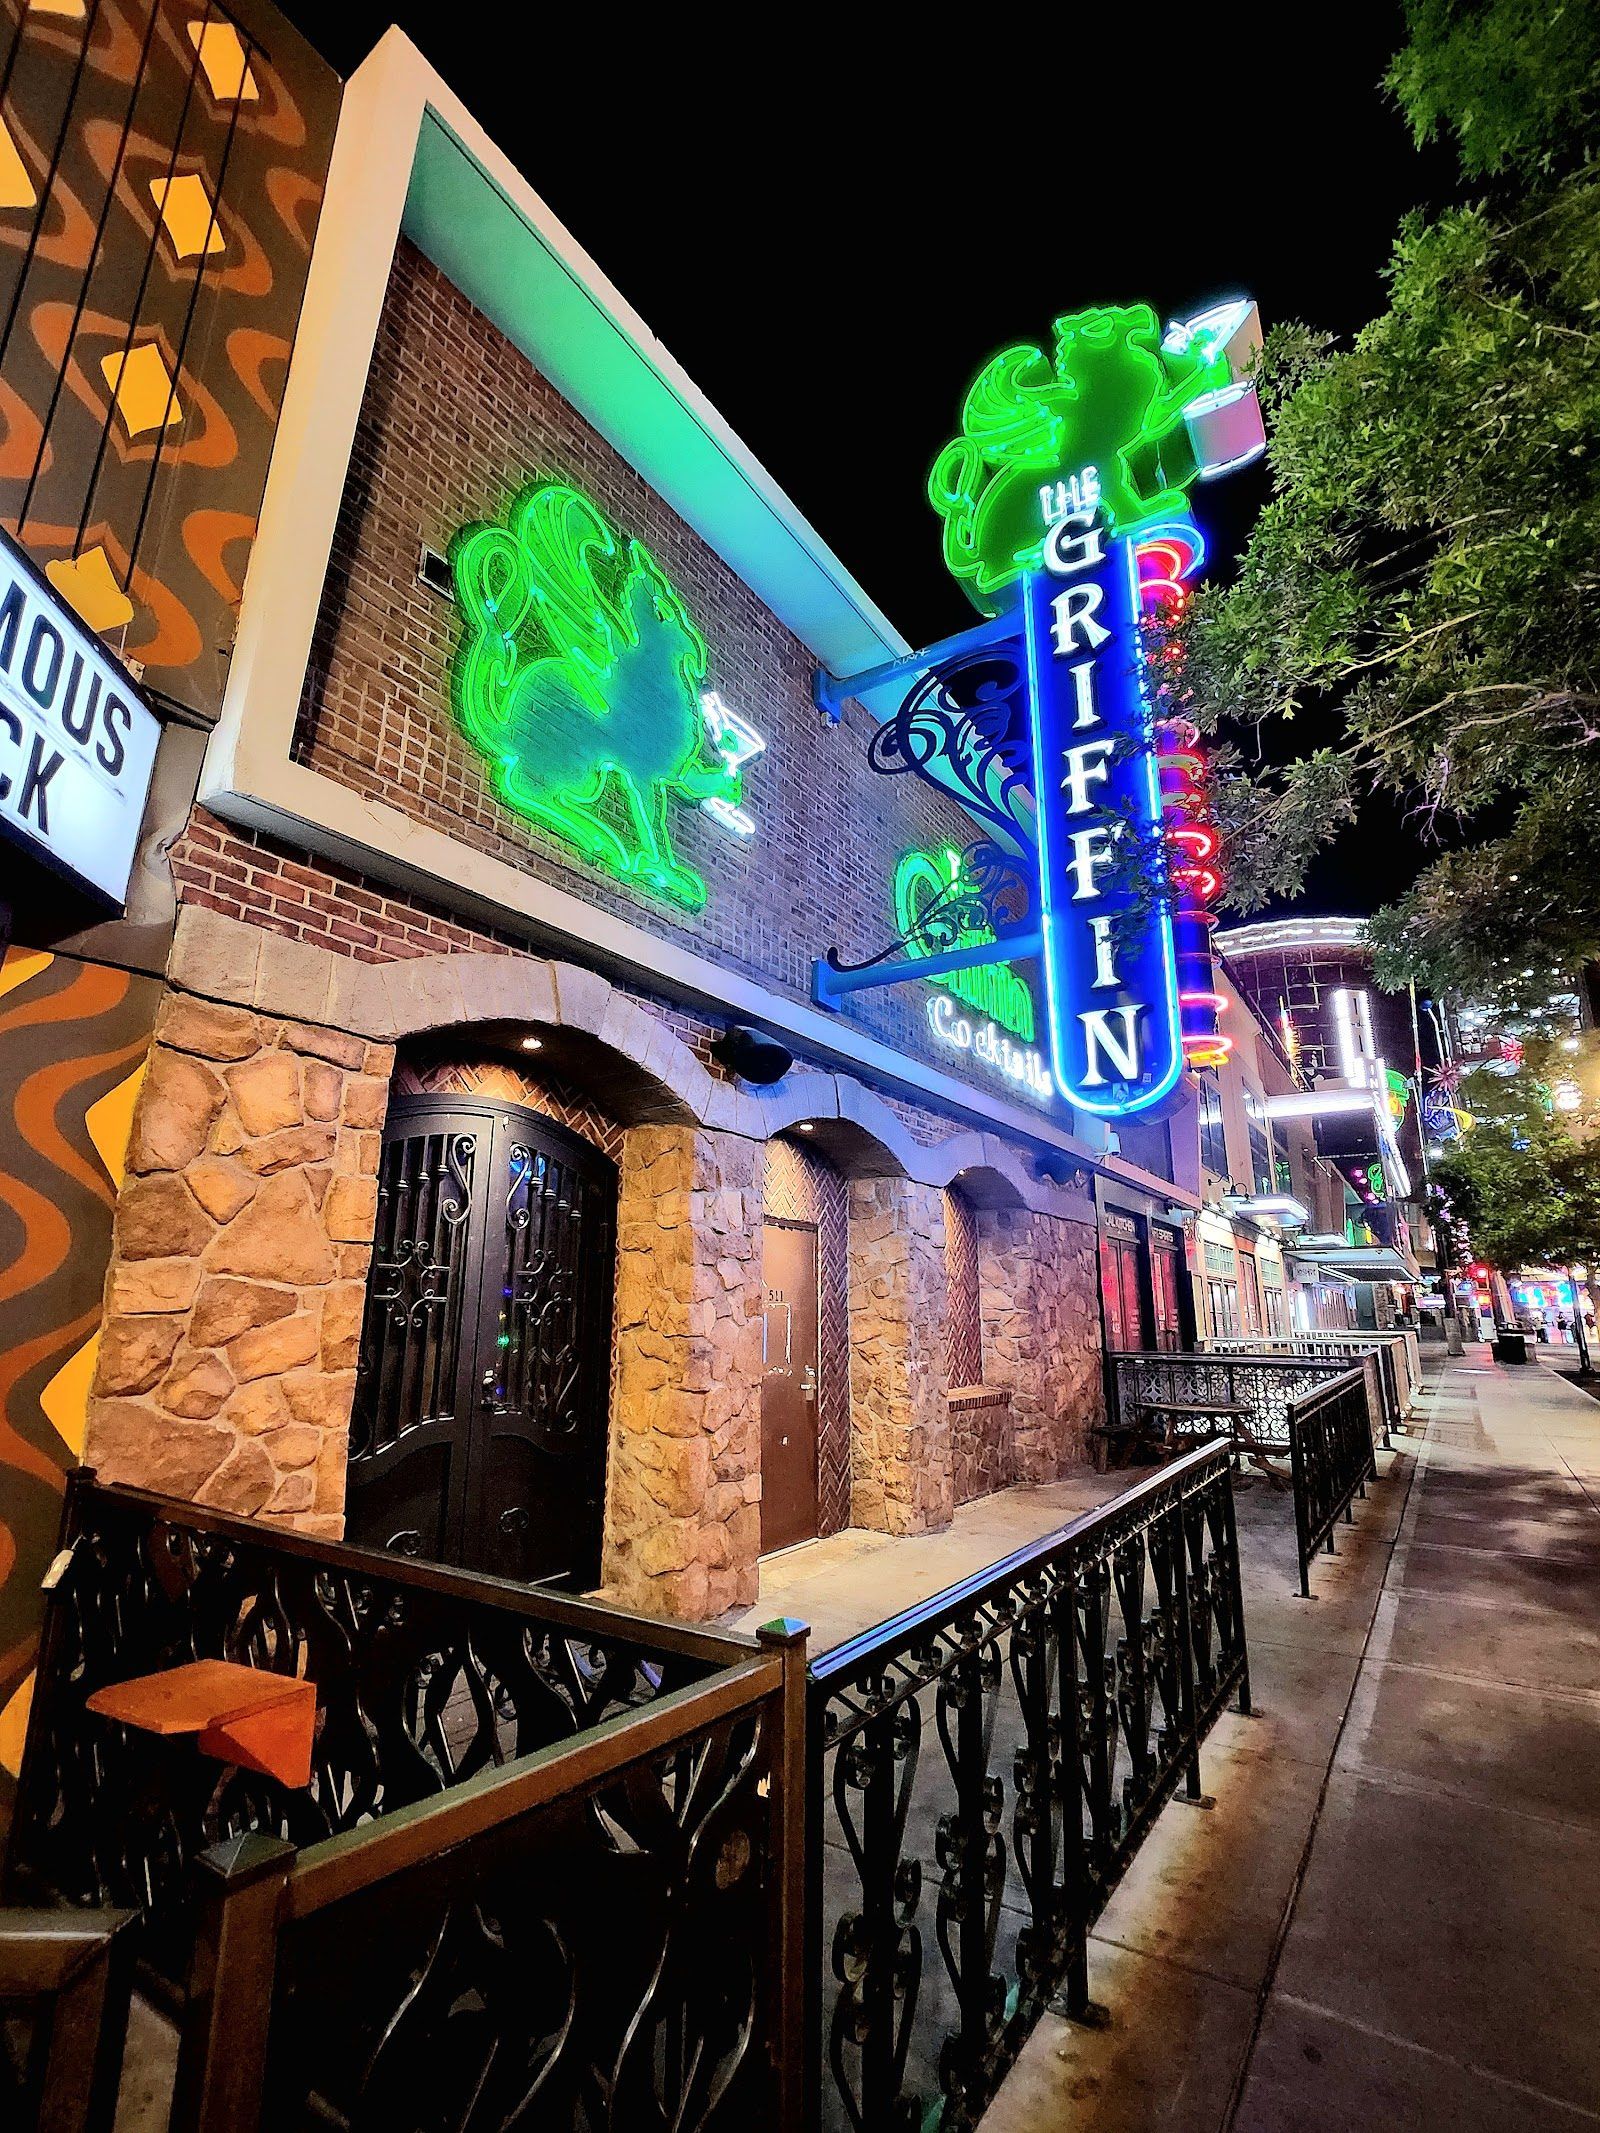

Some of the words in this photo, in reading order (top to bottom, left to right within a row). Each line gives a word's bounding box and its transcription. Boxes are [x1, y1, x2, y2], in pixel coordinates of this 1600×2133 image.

[1043, 511, 1147, 1086] GRIFFIN
[926, 995, 1053, 1097] Cocktails
[768, 1289, 783, 1302] 511
